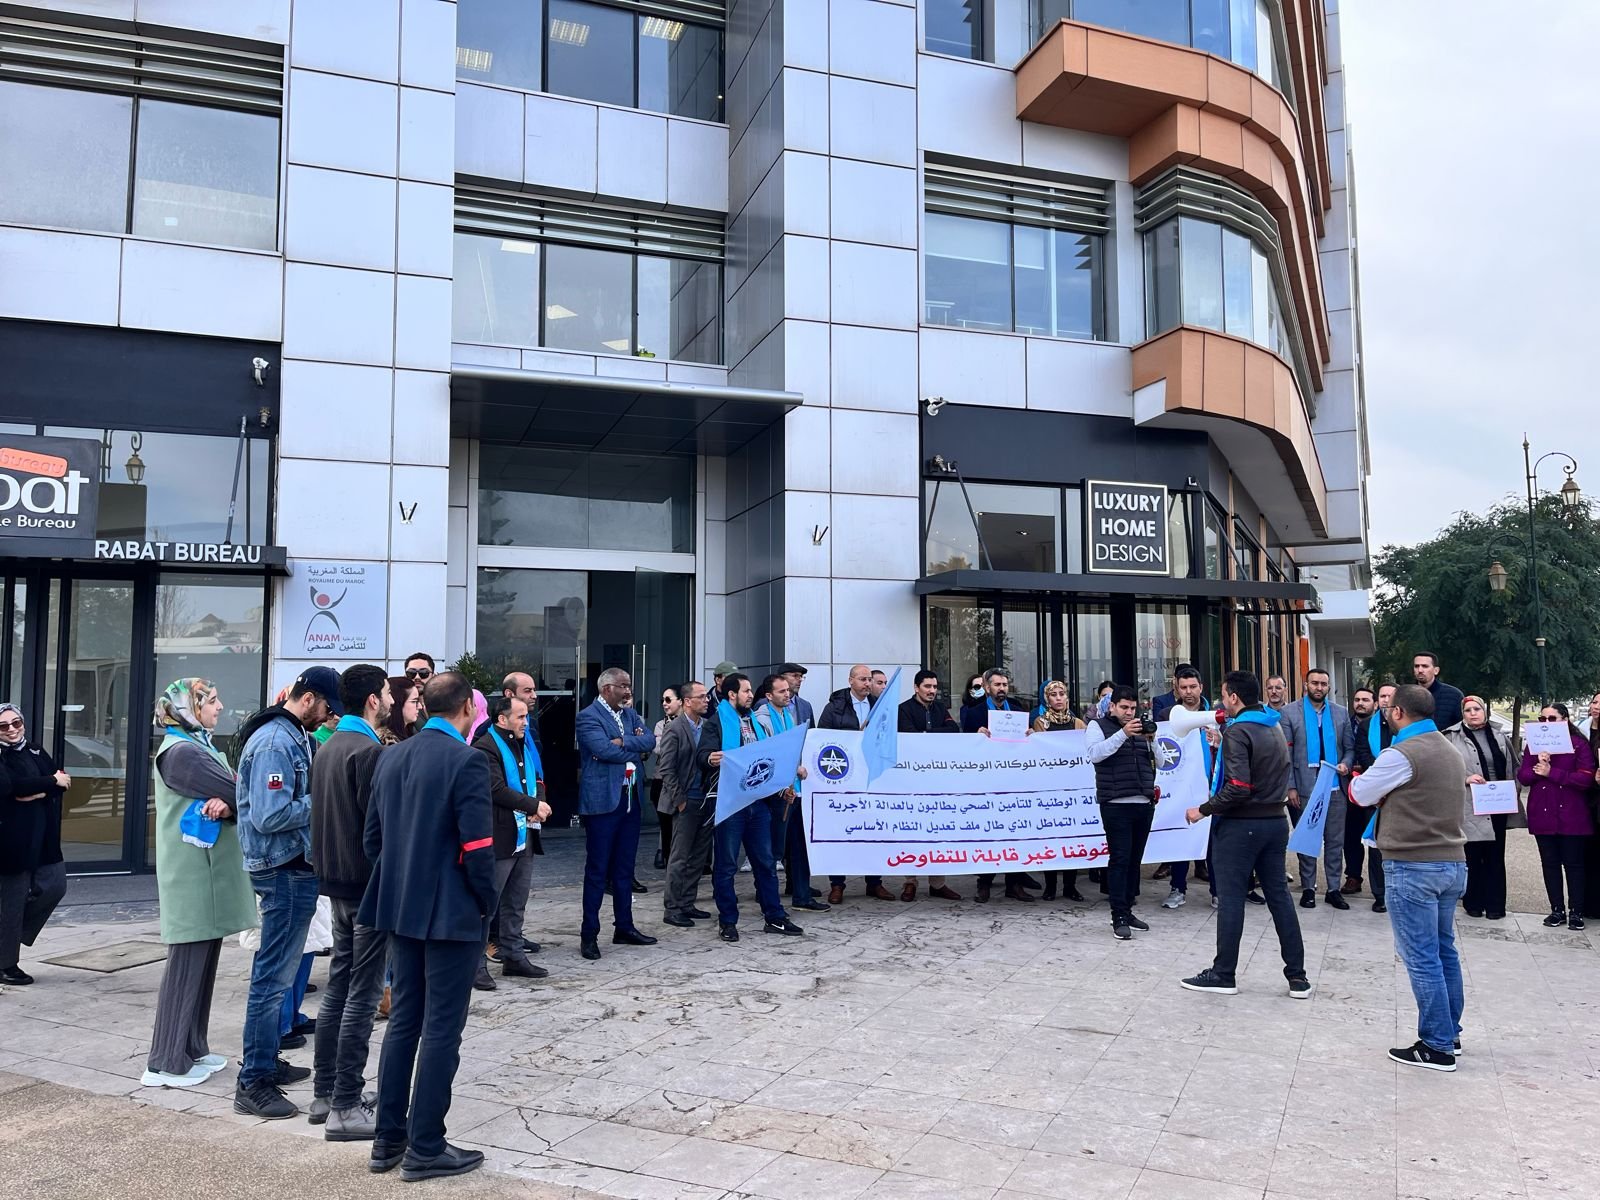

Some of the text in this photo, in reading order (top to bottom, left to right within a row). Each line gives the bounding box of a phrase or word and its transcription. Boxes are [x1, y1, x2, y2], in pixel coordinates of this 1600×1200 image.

[1094, 492, 1161, 512] LUXURY
[17, 514, 76, 528] Bureau
[1100, 518, 1156, 537] HOME
[94, 540, 261, 563] RABAT BUREAU
[1095, 543, 1163, 563] DESIGN
[308, 565, 365, 577] المملكة المغربية
[308, 634, 340, 642] ANAM
[307, 641, 366, 654] للتأمين الصحي
[912, 759, 948, 771] للتأمين
[949, 760, 992, 772] الوطنية
[995, 759, 1037, 770] للوكالة
[1039, 756, 1083, 769] الوطنية
[828, 797, 871, 813] الأجرية
[876, 799, 914, 813] بالعدالة
[917, 800, 957, 814] يطالبون
[960, 800, 994, 814] الصحي
[998, 797, 1032, 812] للتأمين
[1037, 796, 1077, 810] الوطنية
[845, 815, 1100, 834] ضد التماطل الذي طال ملف تعديل النظام الأساسي
[887, 842, 1110, 868] قوقنا غير قابلة للتفاوض
